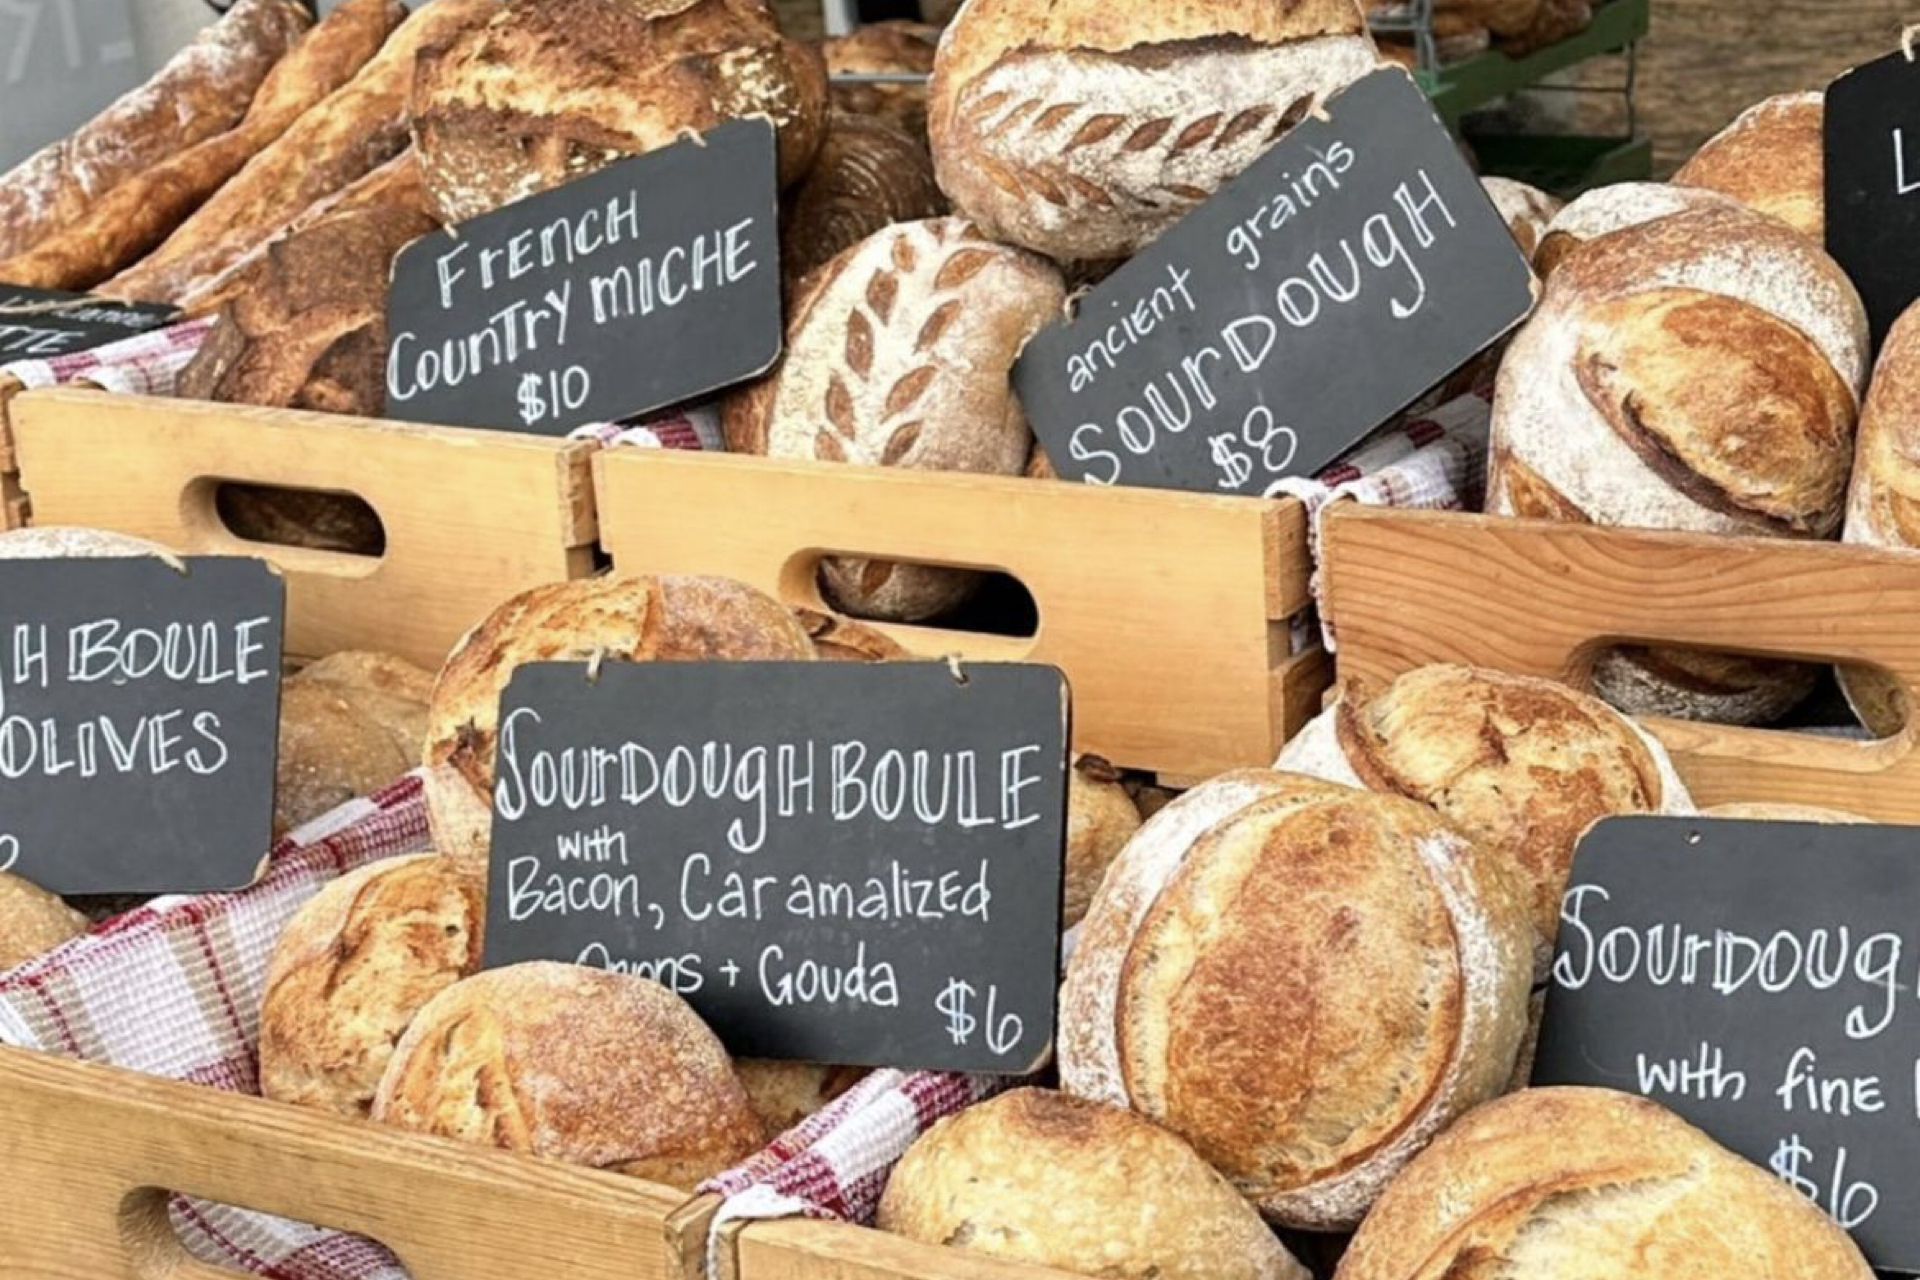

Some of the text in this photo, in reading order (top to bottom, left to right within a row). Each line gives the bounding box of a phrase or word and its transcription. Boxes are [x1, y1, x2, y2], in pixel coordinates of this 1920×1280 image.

[1067, 139, 1355, 393] ancient grains
[516, 365, 590, 425] $10
[1209, 405, 1298, 489] $8
[67, 615, 271, 684] BOULE
[0, 708, 229, 778] OLIVES
[831, 739, 1042, 830] BOULE
[557, 825, 628, 866] with
[508, 856, 666, 930] Bacon,
[758, 940, 899, 1007] Gouda
[935, 976, 1024, 1055] $6
[1636, 1041, 1747, 1101] with
[1768, 1132, 1879, 1229] $6
